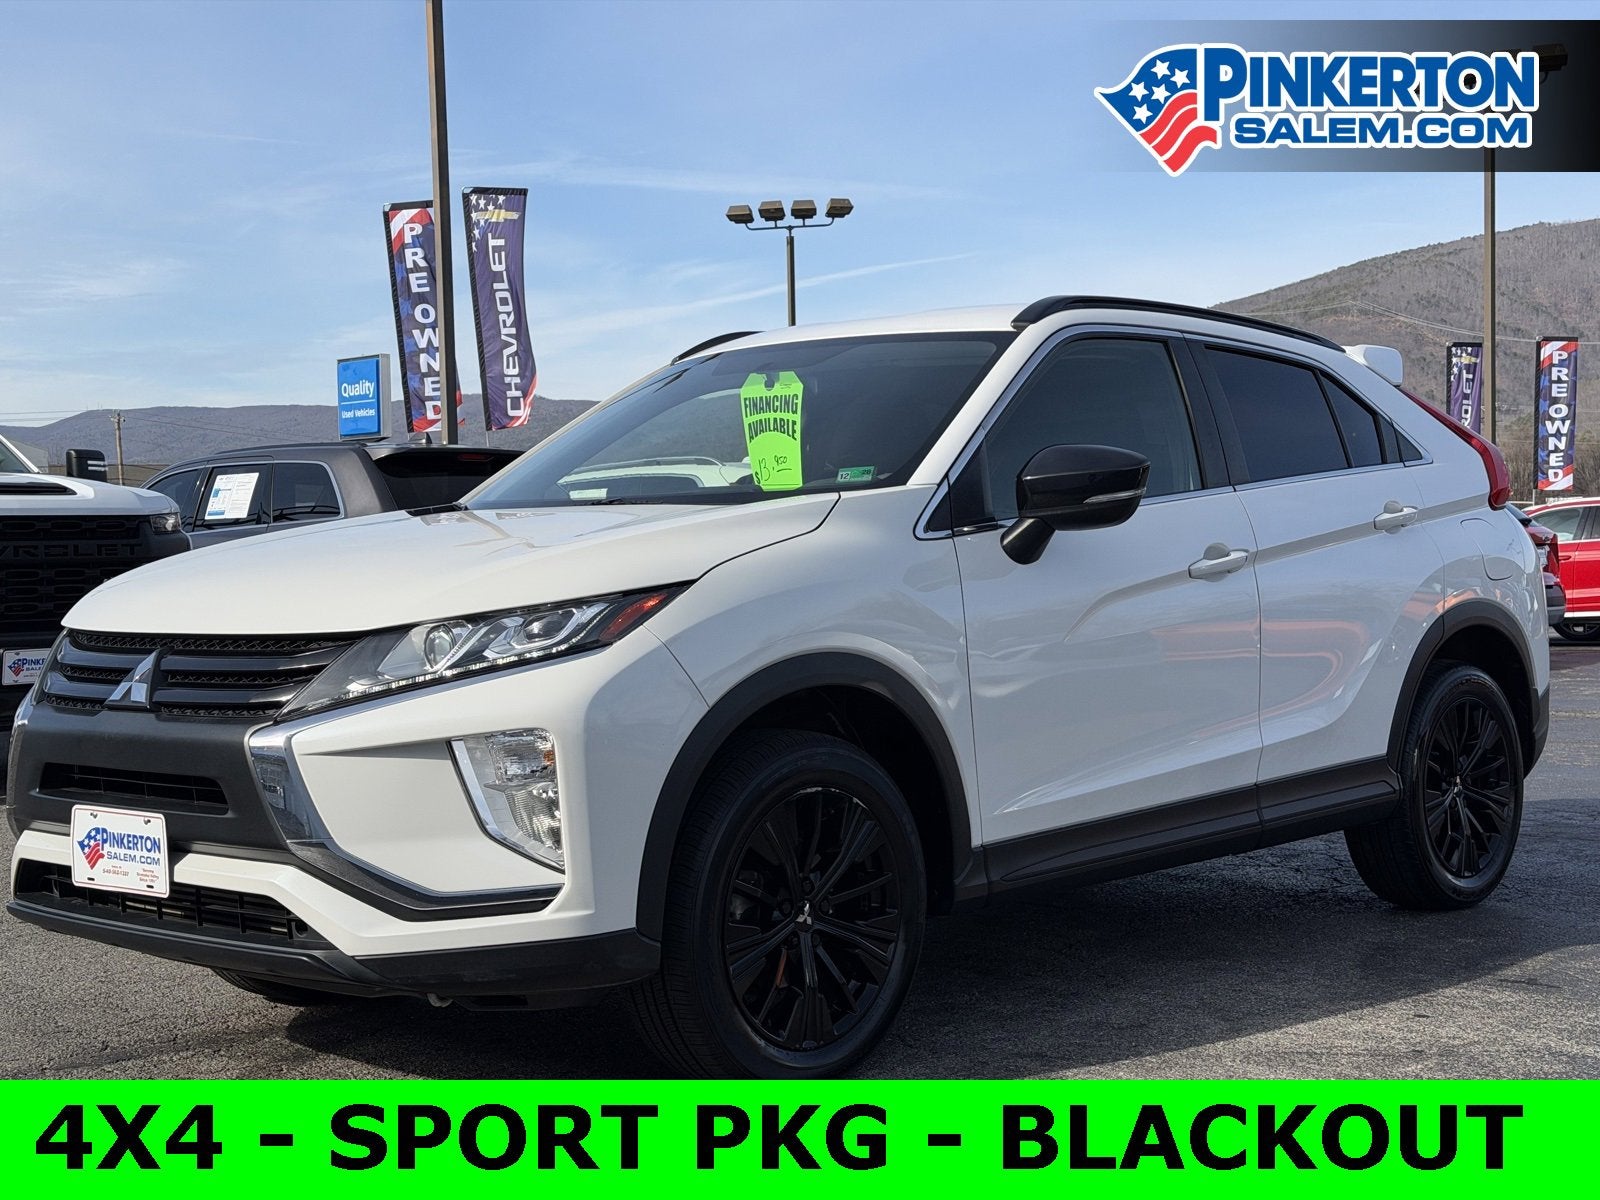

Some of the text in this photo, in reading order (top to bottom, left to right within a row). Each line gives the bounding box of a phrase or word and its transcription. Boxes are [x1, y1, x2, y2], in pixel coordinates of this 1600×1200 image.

[403, 223, 442, 420] PRE OWNED
[487, 232, 524, 417] CHEVROLET
[341, 380, 375, 398] Quality
[341, 408, 376, 419] Used Vehicles
[743, 393, 799, 418] FINANCING
[1545, 350, 1571, 482] PRE OWNED
[747, 417, 798, 443] AVAILABLE
[101, 827, 161, 855] PINKERTON
[106, 851, 161, 867] SALEM.COM
